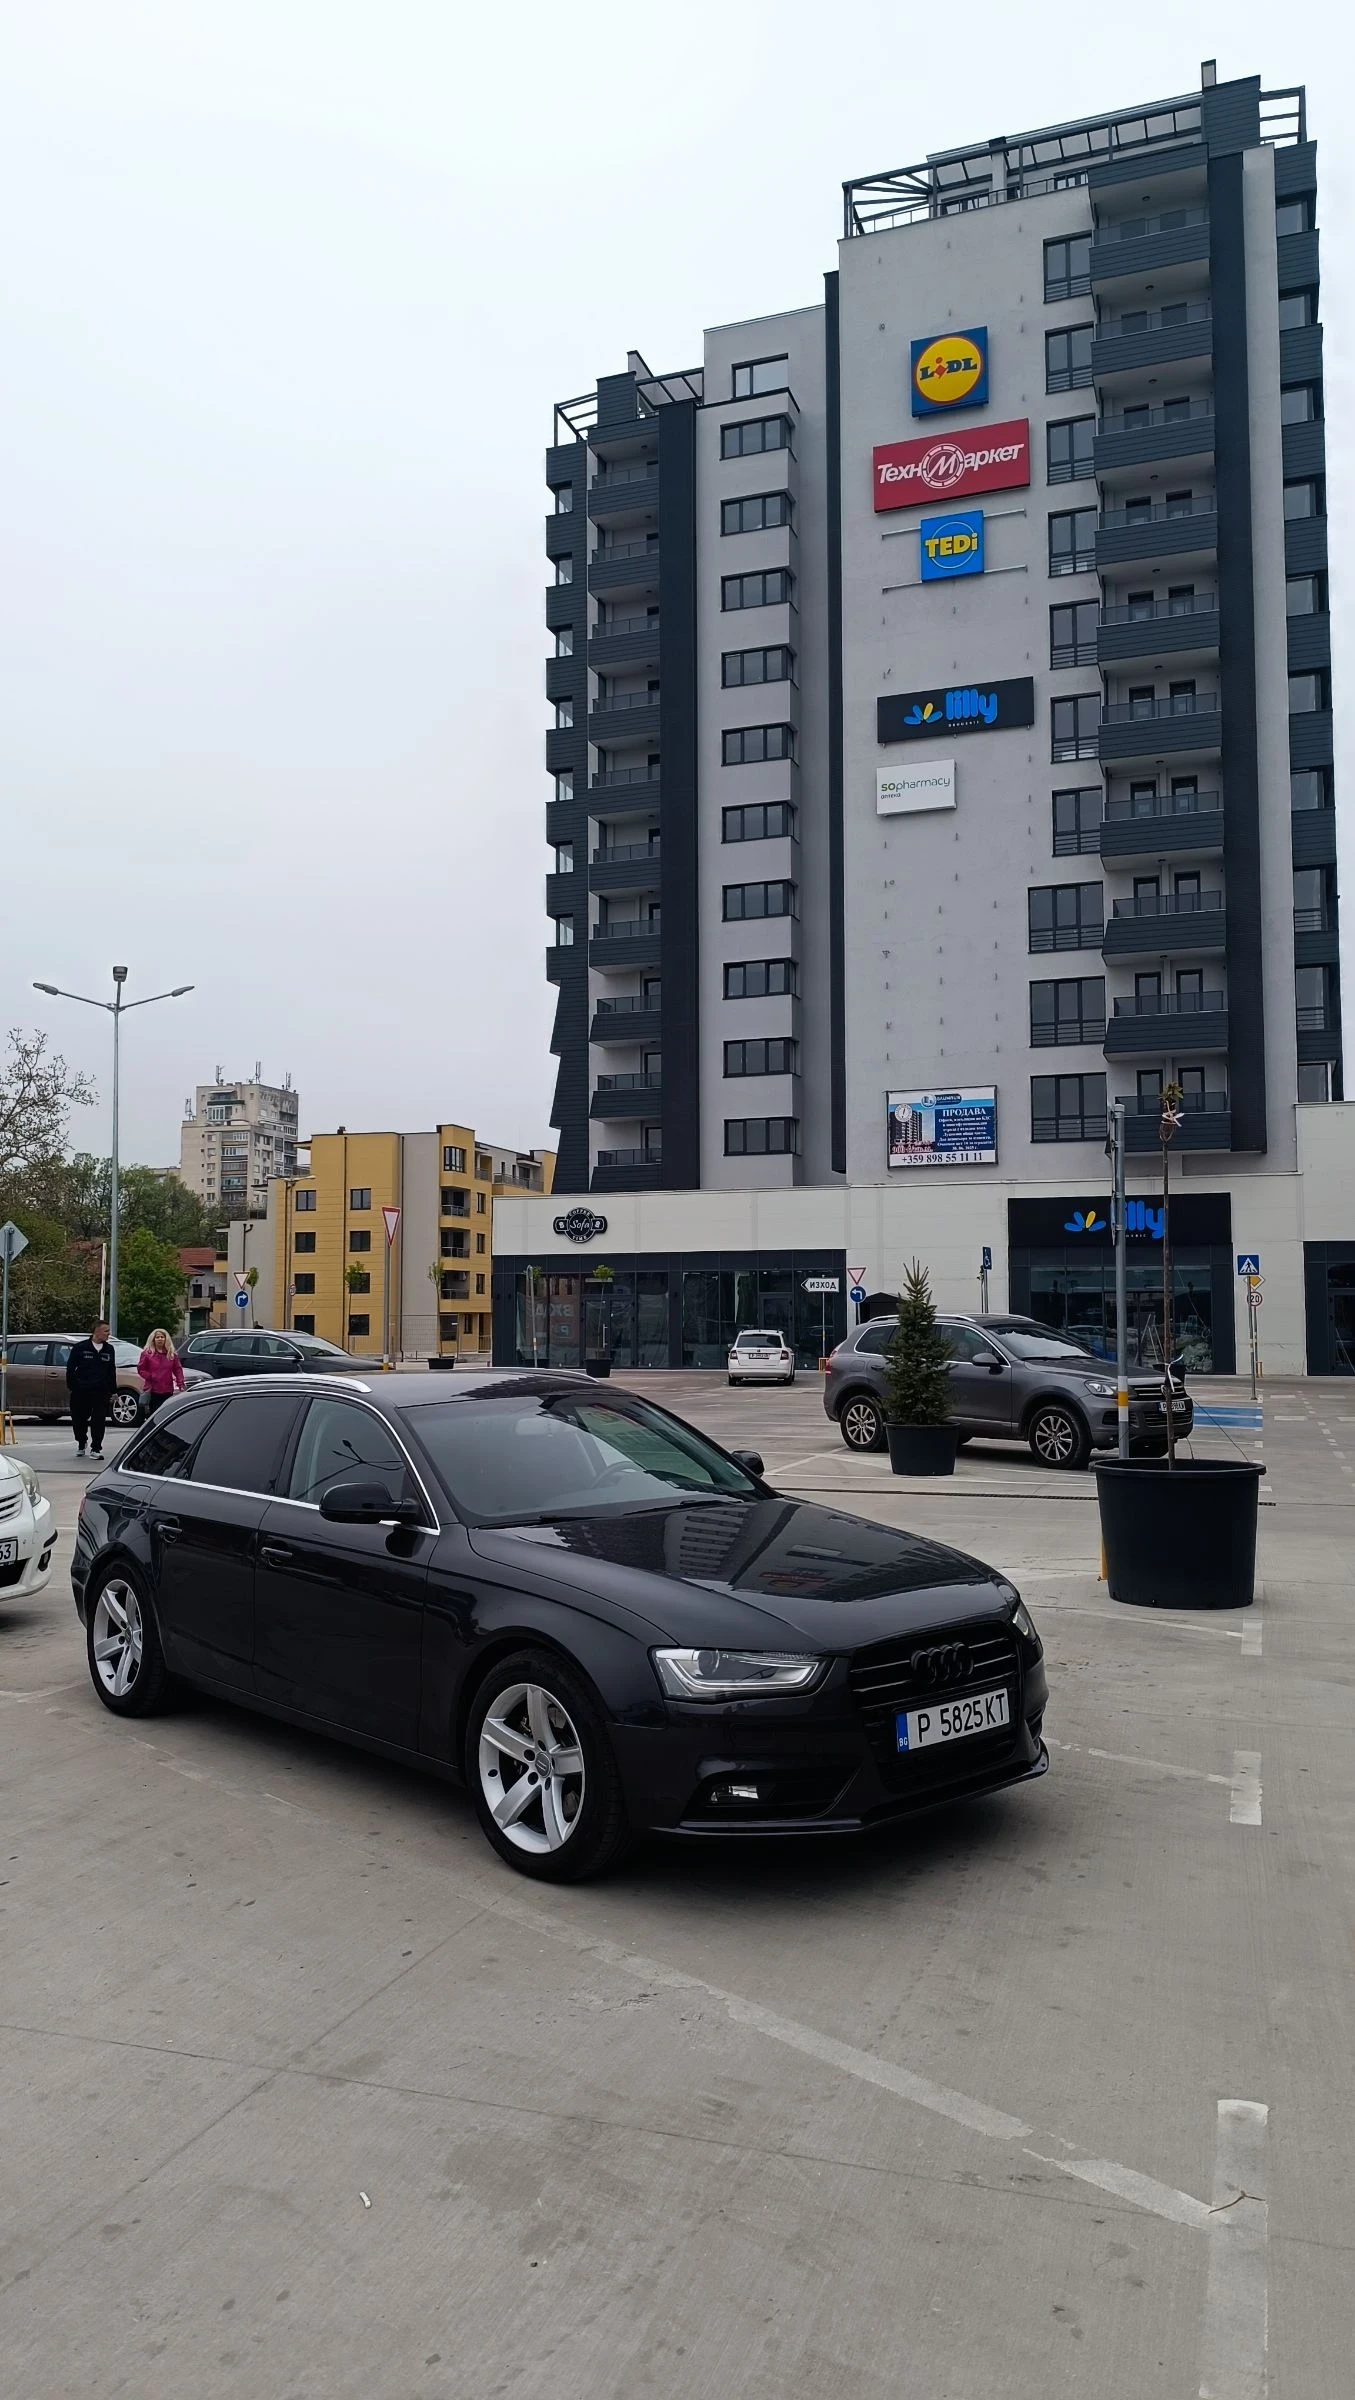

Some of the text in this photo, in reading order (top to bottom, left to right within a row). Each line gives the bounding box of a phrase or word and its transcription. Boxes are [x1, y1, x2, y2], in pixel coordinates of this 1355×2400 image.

[945, 688, 997, 724] lilly
[881, 777, 951, 793] sopharmacy
[942, 1107, 986, 1117] ПРОДАВА
[902, 1152, 982, 1164] +359 898 55 11 11
[570, 1218, 590, 1232] Sofa
[809, 1281, 837, 1290] ИЗХОД
[1250, 1294, 1260, 1303] 20
[917, 1693, 1005, 1743] P 5825 KT
[899, 1737, 908, 1747] BG
